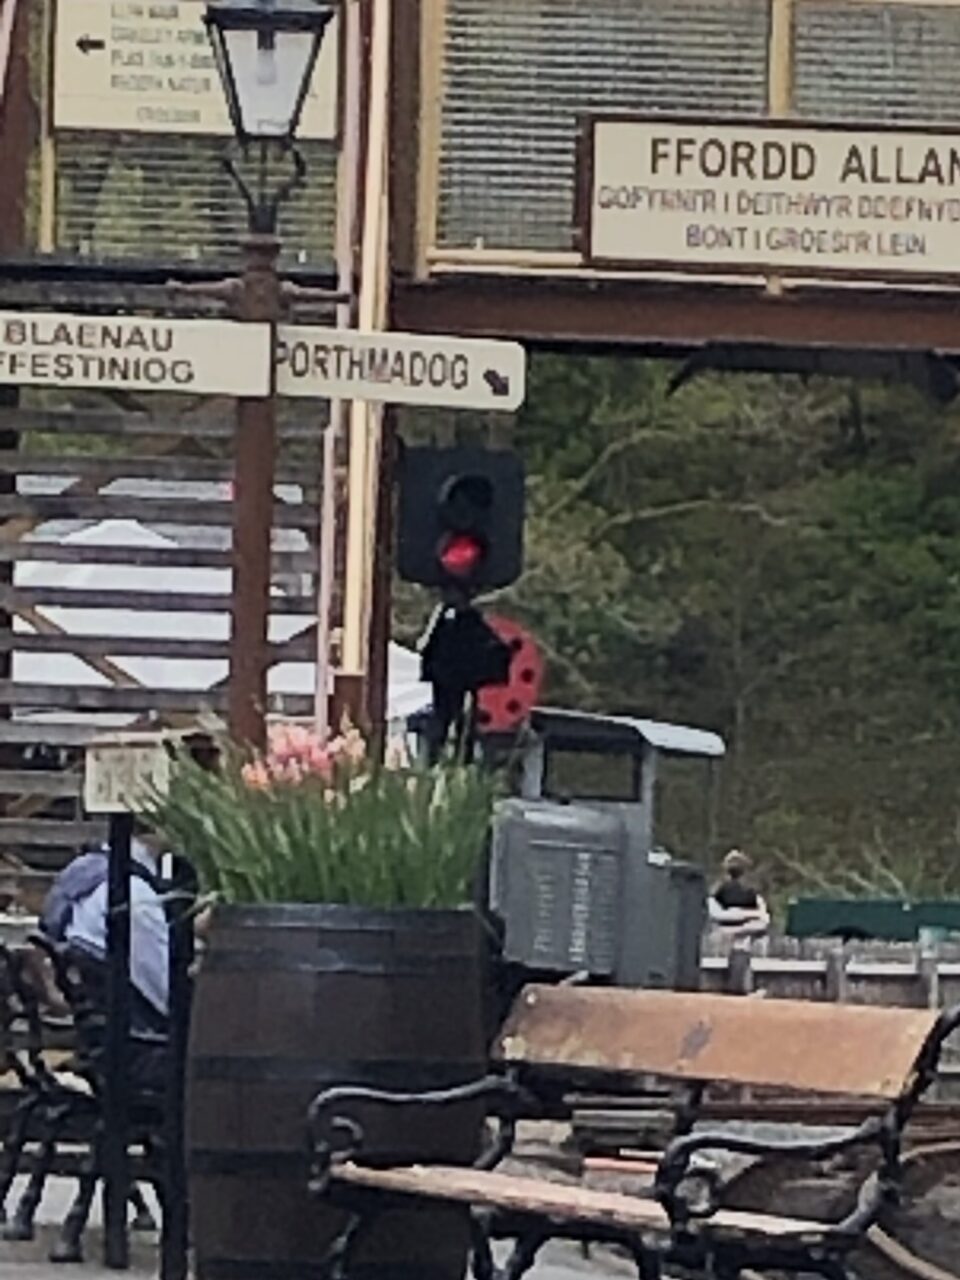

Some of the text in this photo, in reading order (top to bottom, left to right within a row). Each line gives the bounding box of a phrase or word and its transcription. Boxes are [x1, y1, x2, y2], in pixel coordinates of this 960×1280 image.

[650, 136, 816, 181] FFORDD
[685, 223, 748, 249] BONT
[4, 318, 174, 352] BLAENAU
